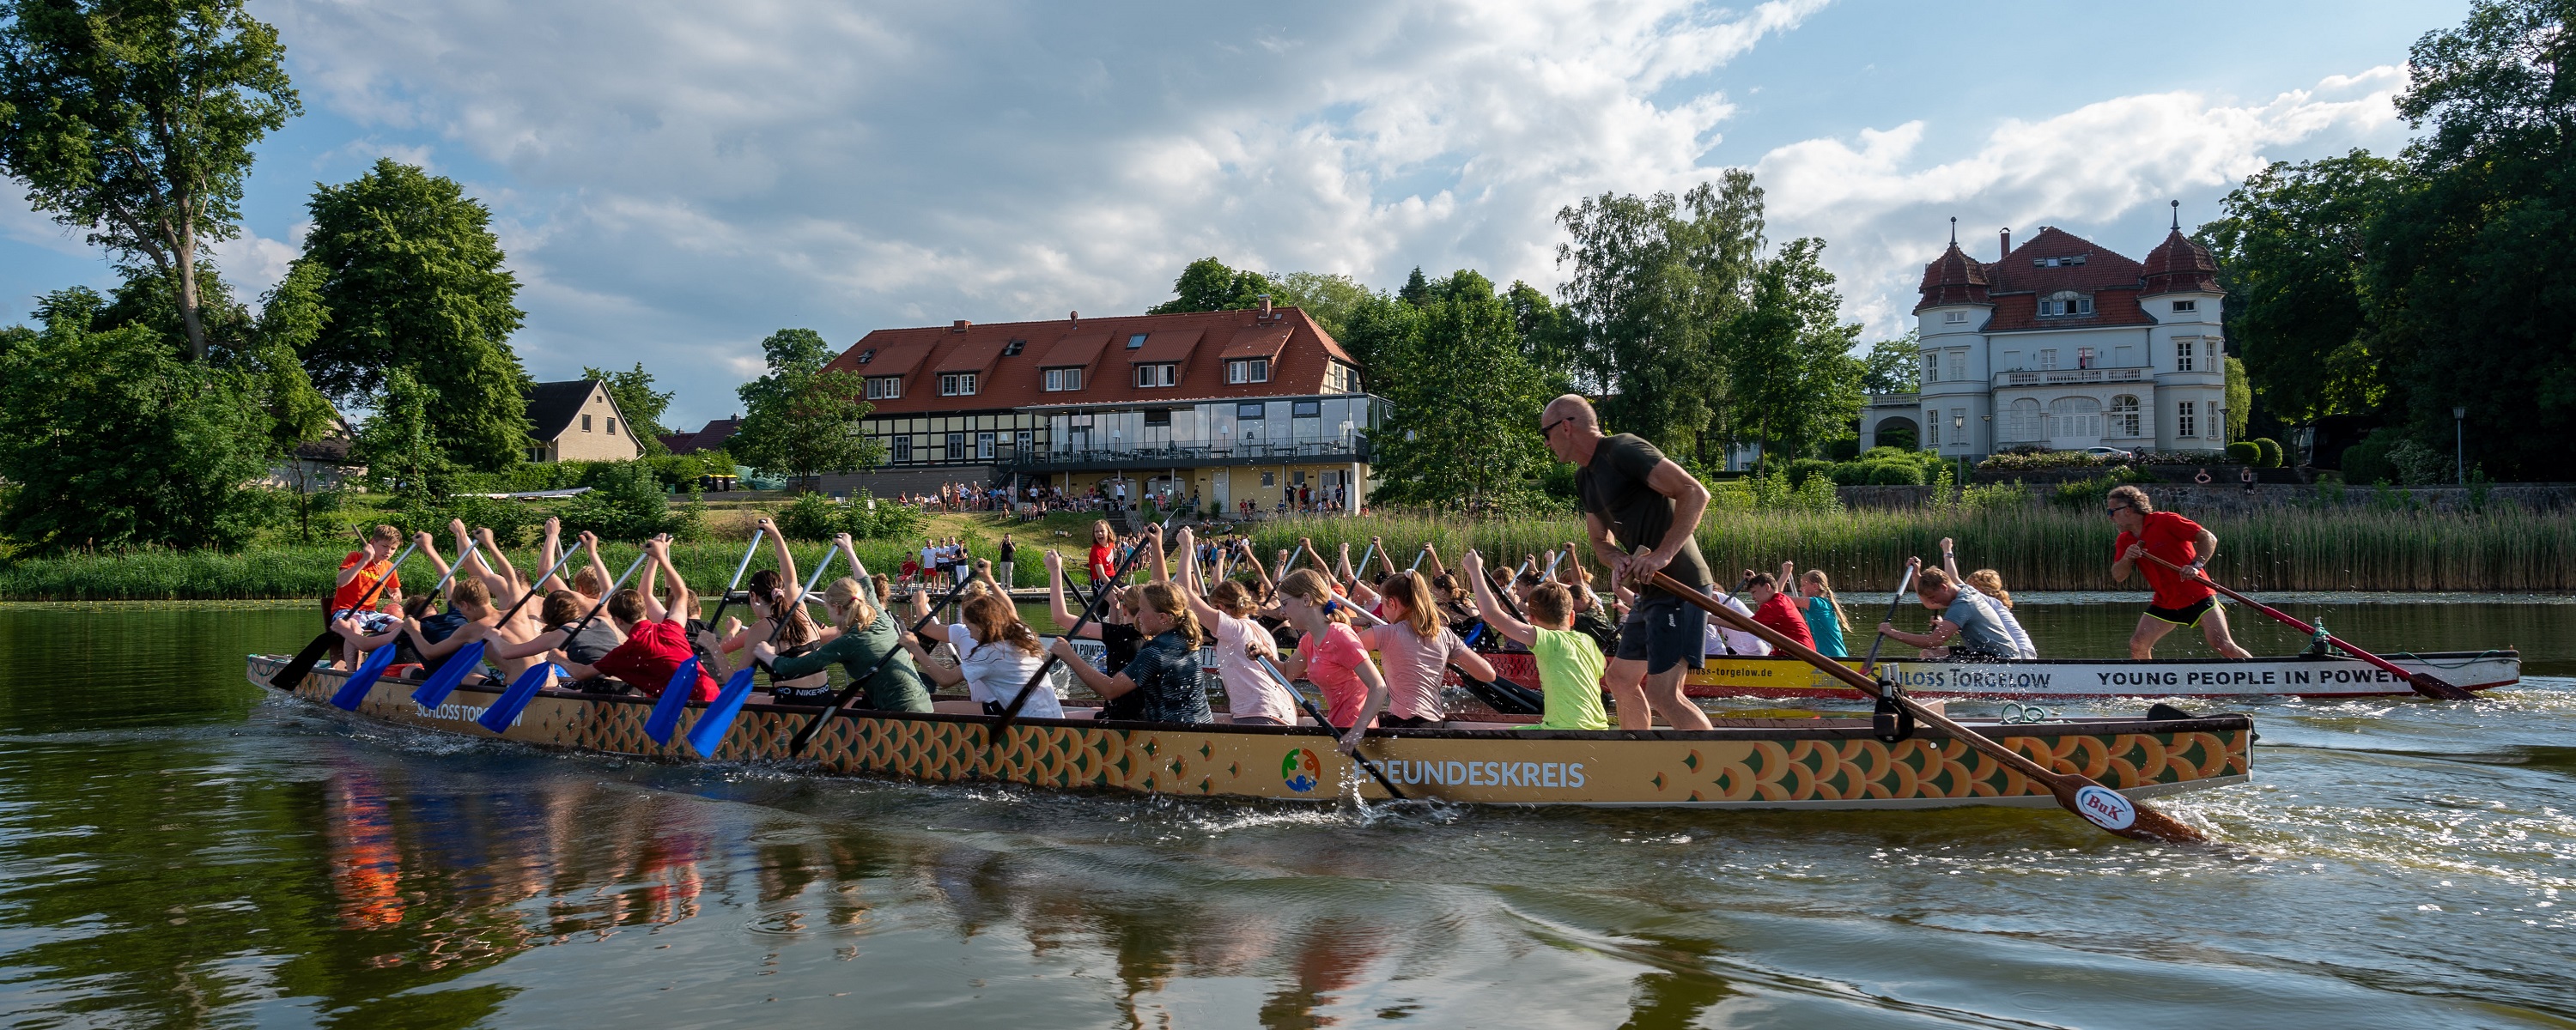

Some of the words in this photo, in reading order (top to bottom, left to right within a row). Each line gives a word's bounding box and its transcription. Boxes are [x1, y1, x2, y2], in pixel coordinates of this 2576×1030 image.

[1949, 668, 2051, 688] TORGELOW
[2097, 672, 2178, 686] YOUNG
[2187, 671, 2275, 685] PEOPLE
[2285, 670, 2310, 684] IN
[795, 688, 817, 697] NIKE
[1354, 760, 1586, 788] FREUNDESKREIS
[2086, 794, 2125, 821] BuK
